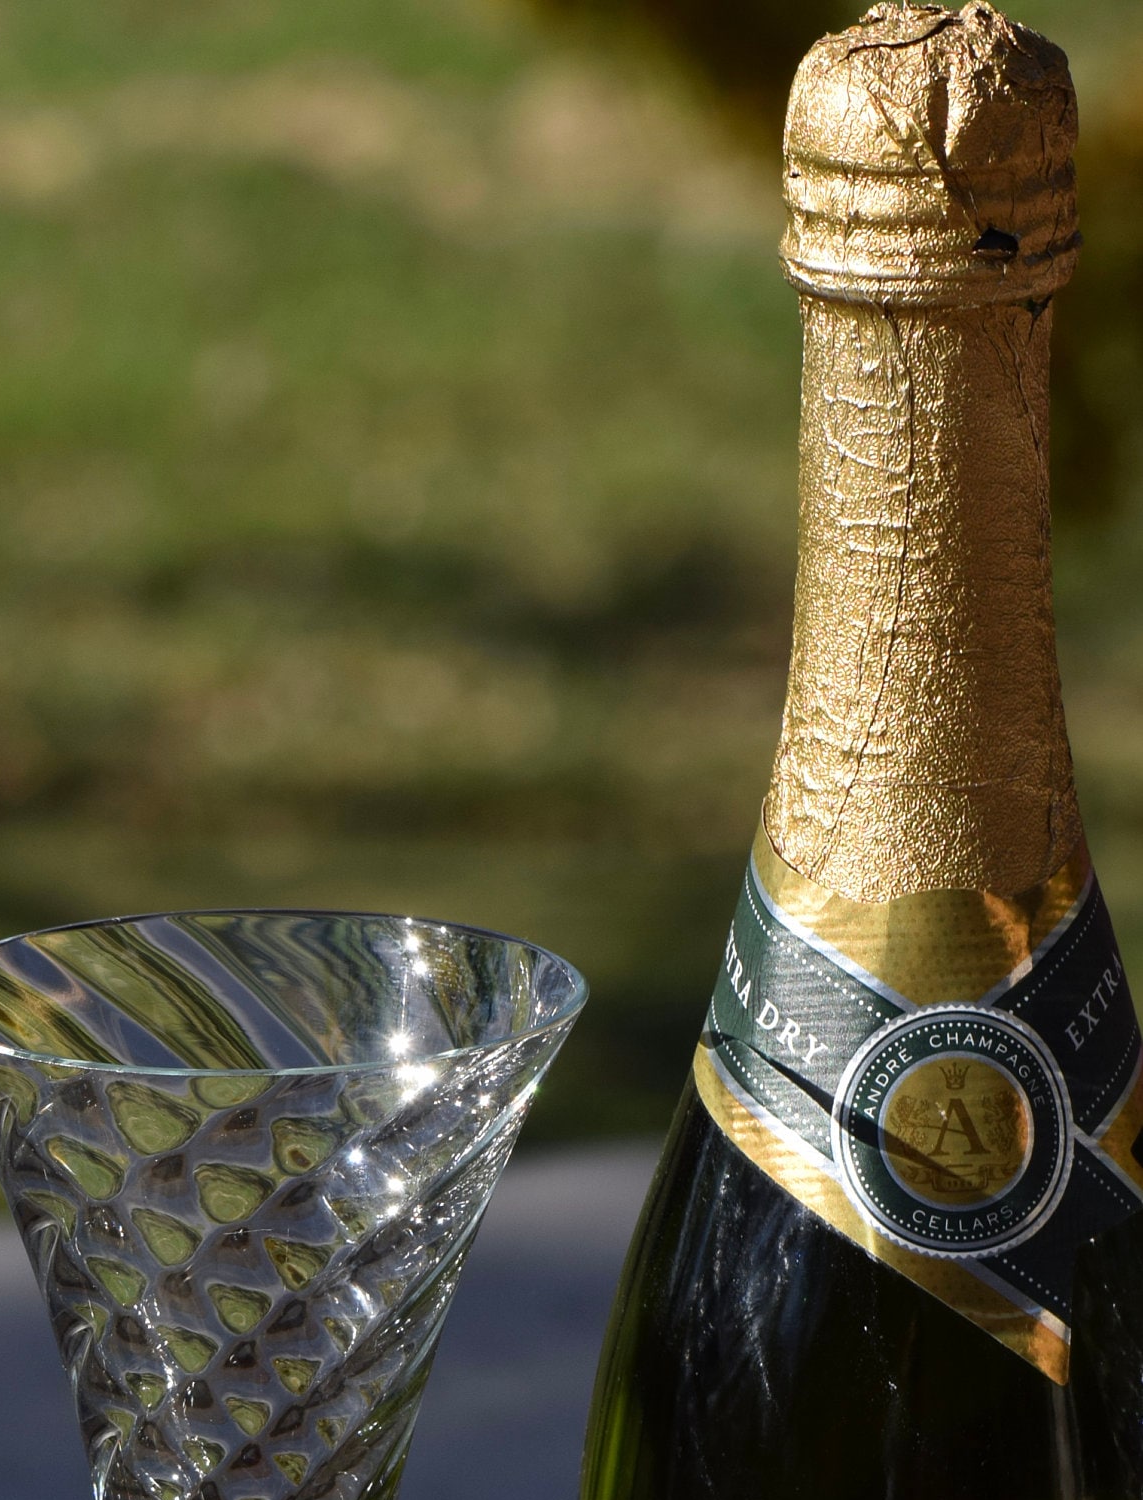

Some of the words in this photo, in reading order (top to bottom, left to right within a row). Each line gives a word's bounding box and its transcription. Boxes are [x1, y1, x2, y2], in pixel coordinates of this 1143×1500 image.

[725, 919, 752, 1010] XTRA
[755, 998, 829, 1065] DRY
[929, 1032, 1045, 1107] CHAMPAGNE
[912, 1205, 1013, 1233] CELLARS
